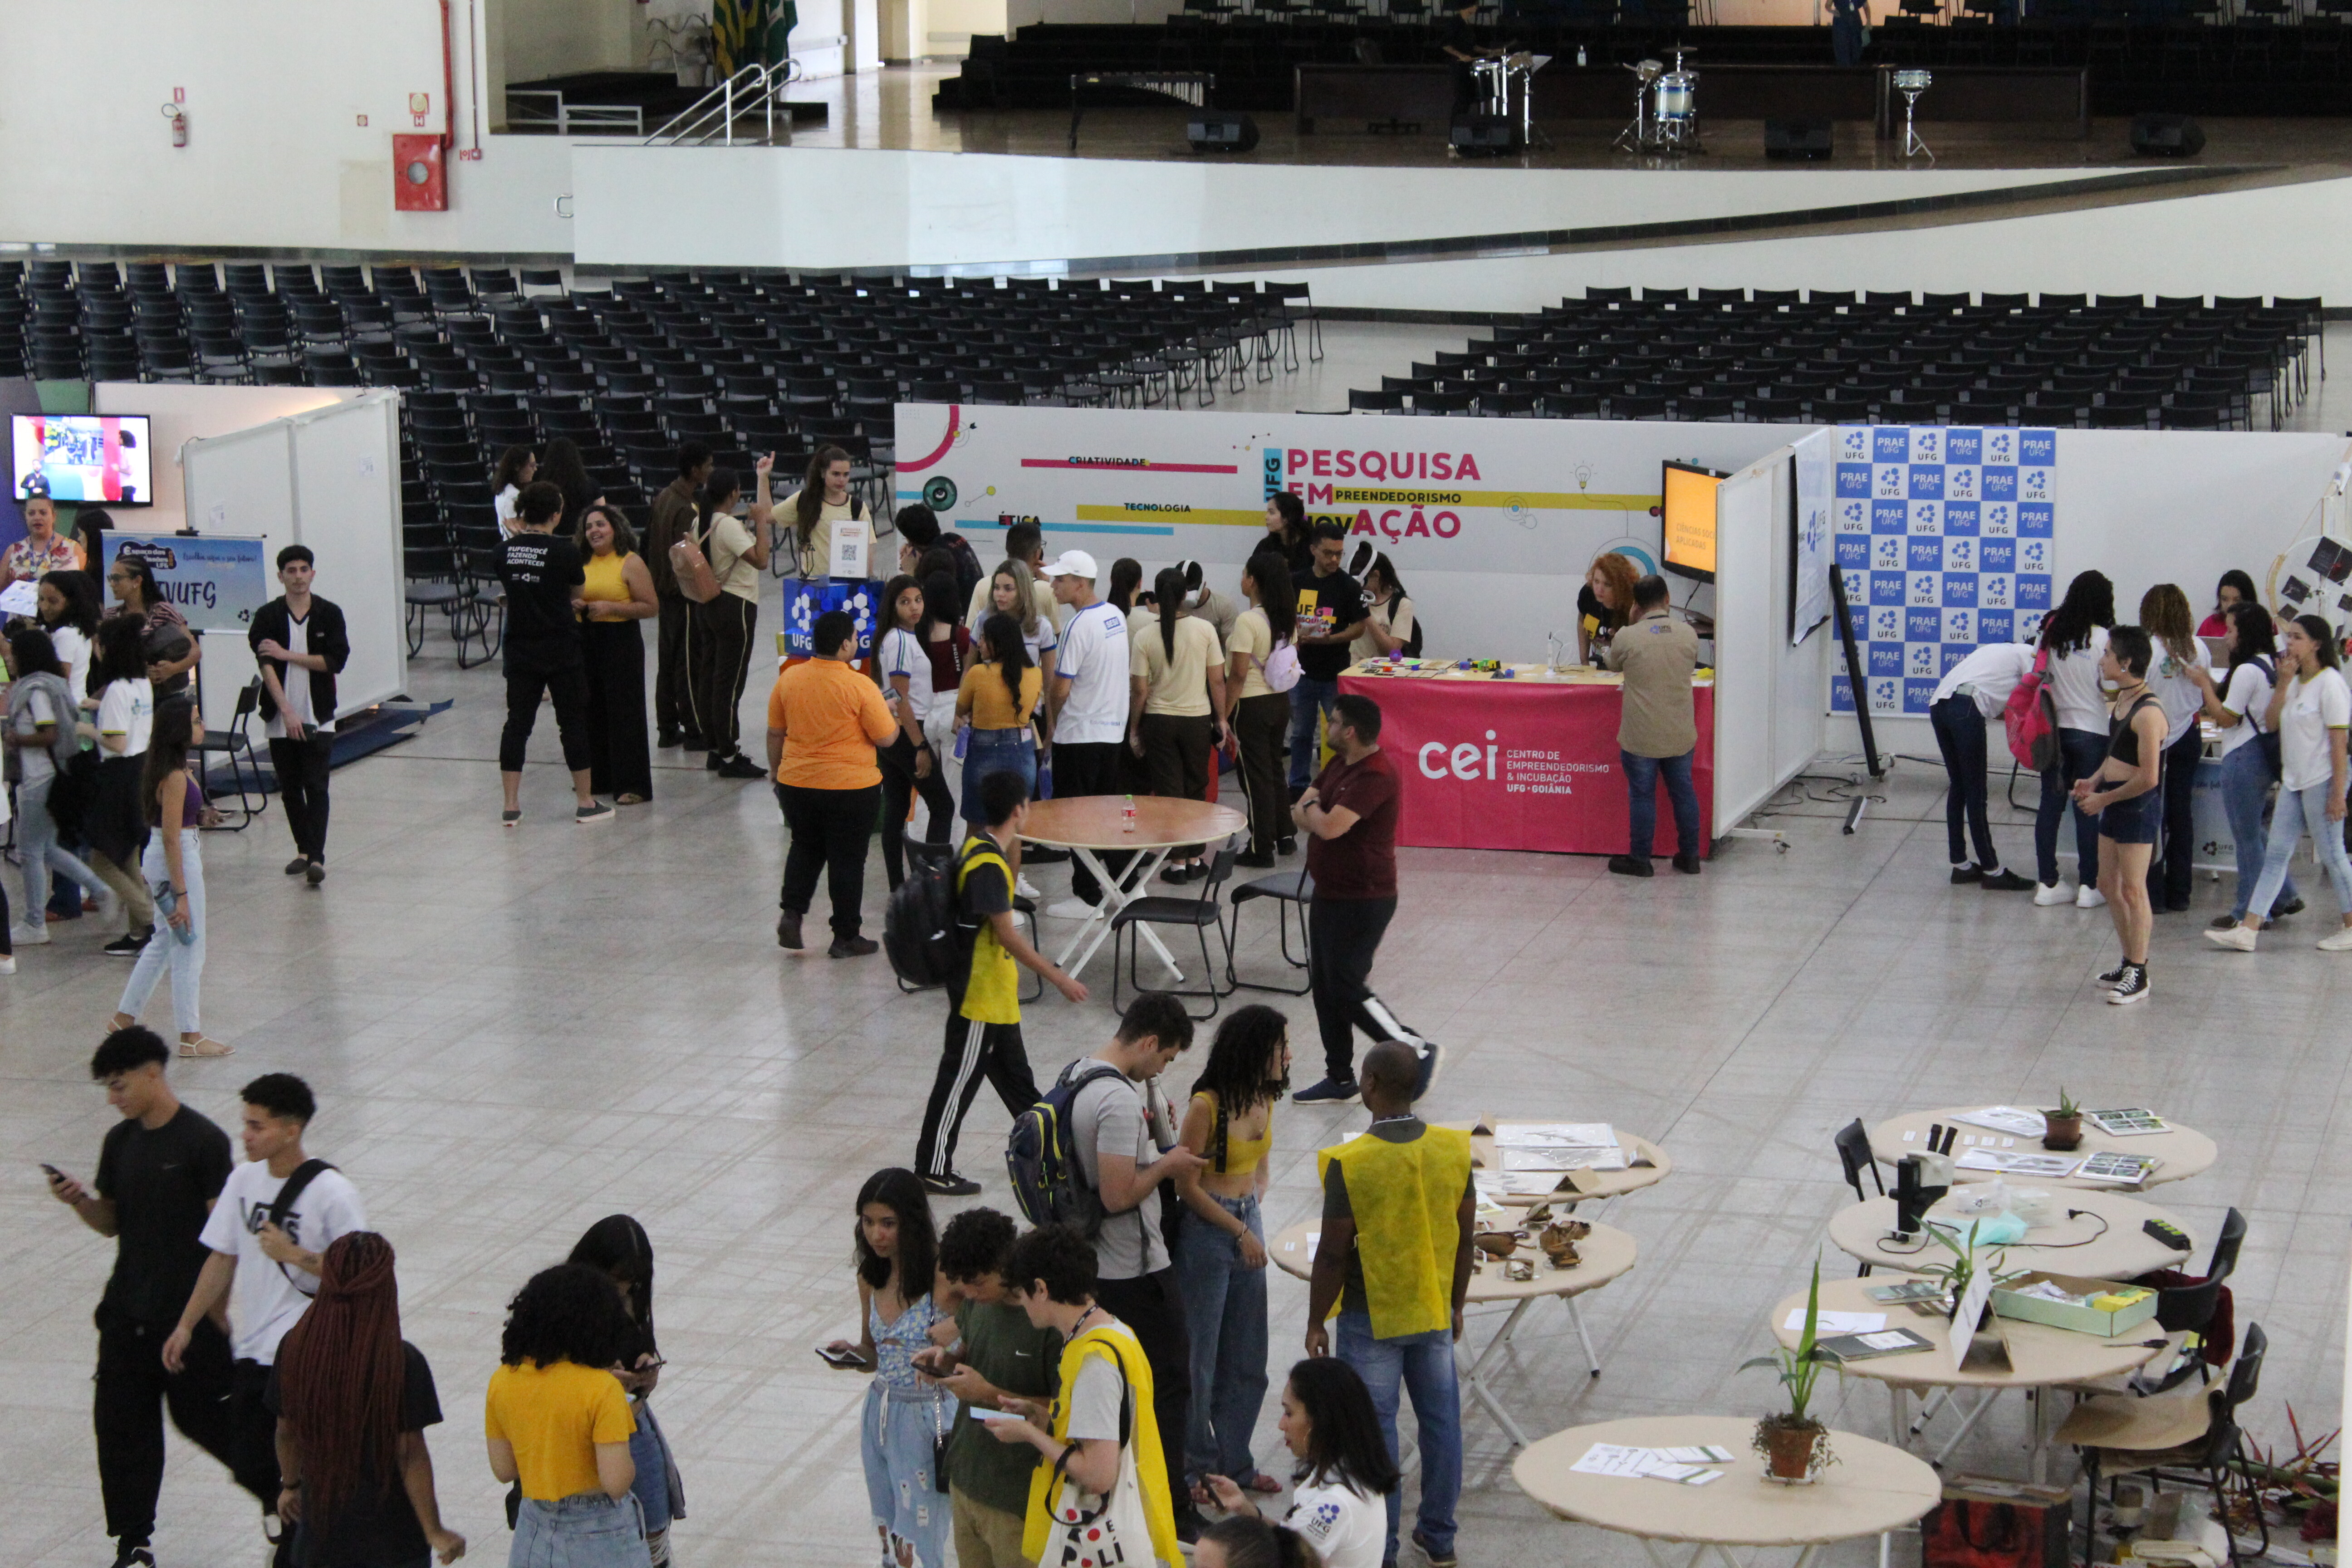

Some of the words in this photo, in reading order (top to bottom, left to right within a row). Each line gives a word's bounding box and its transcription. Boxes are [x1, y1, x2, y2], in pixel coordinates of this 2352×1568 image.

[1878, 437, 1905, 446] PRAE
[1951, 439, 1977, 448] PRAE
[2024, 441, 2051, 449] PRAE
[1068, 456, 1146, 466] CRIATIVIDADE
[1288, 449, 1481, 482] PESQUISA
[1841, 473, 1867, 481] PRAE
[1913, 474, 1940, 483] PRAE
[1986, 476, 2013, 485] PRAE
[1336, 490, 1461, 503] PREENDEDORISMO
[1124, 503, 1191, 513] TECNOLOGIA
[1876, 509, 1903, 518] PRAE
[1949, 511, 1975, 519] PRAE
[2022, 512, 2049, 521] PRAE
[1676, 523, 1701, 536] CIÊNCIAS
[1676, 536, 1706, 550] APLICADAS
[508, 546, 548, 554] #UFGEVOCÊ
[1839, 544, 1866, 553] PRAE
[1911, 546, 1938, 554] PRAE
[1984, 547, 2011, 556] PRAE
[507, 559, 544, 567] ACONTECER
[1875, 580, 1901, 589] PRAE
[1947, 582, 1974, 591] PRAE
[2019, 584, 2047, 593] PRAE
[1910, 617, 1936, 625] PRAE
[1982, 619, 2009, 627] PRAE
[793, 634, 812, 651] UFG
[952, 644, 960, 671] PANTONE
[1873, 652, 1900, 660] PRAE
[1945, 653, 1967, 662] PRA
[1419, 730, 1498, 780] cei
[1507, 750, 1544, 759] CENTRO
[1547, 751, 1560, 760] DE
[1507, 761, 1609, 773] EMPREENDEDORISMO
[1517, 773, 1571, 783] INCUBAÇÃO
[1532, 784, 1572, 794] GOIÂNIA
[1312, 1517, 1331, 1533] UFG
